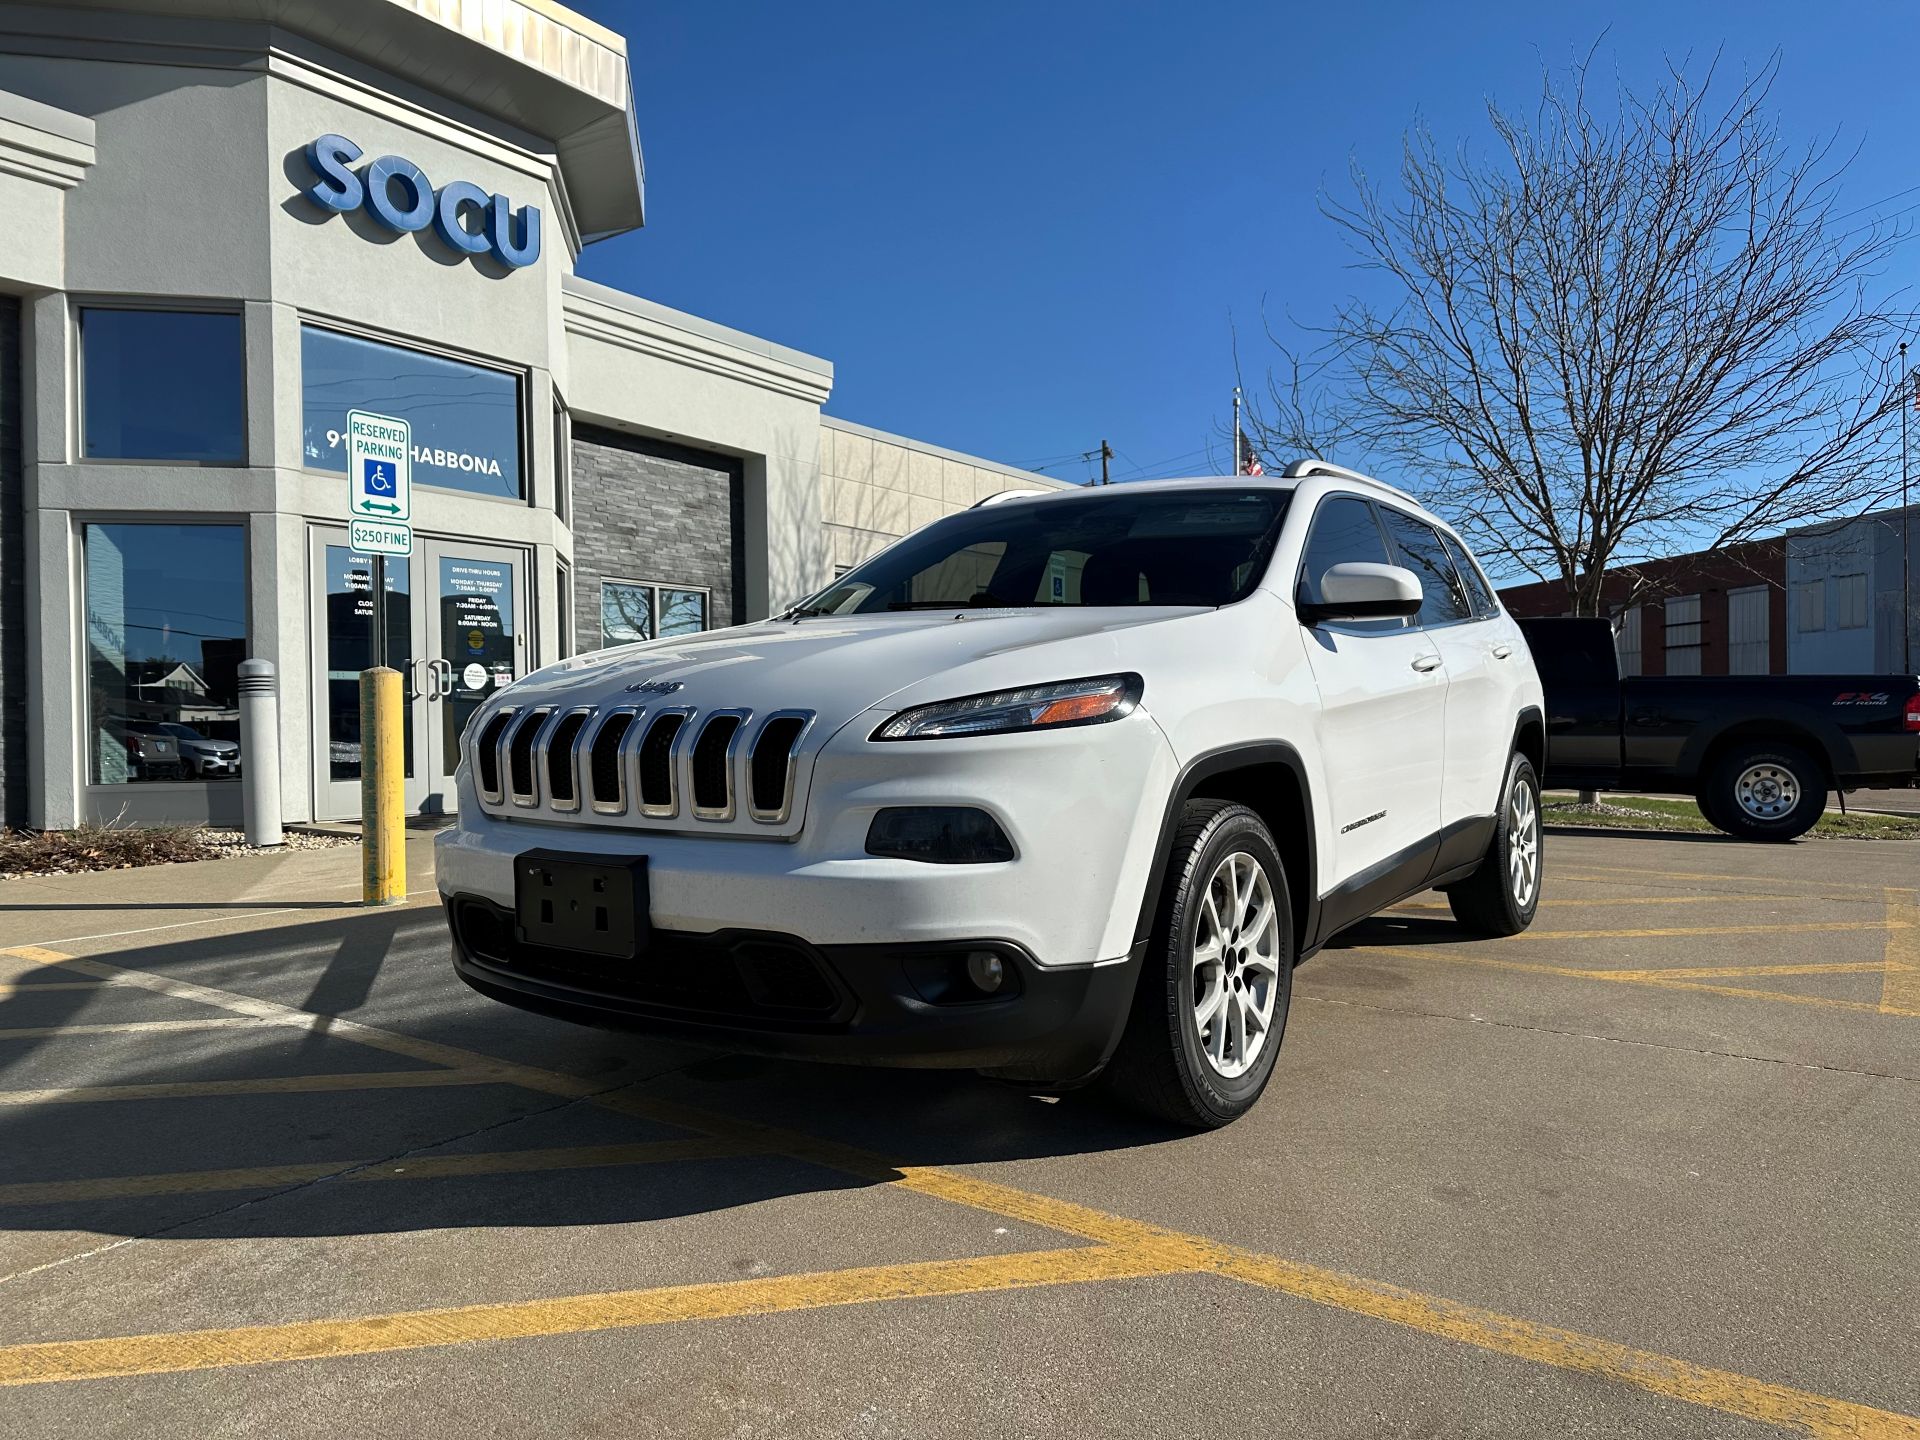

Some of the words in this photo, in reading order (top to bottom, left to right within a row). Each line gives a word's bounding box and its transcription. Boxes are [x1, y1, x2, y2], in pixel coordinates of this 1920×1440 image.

[306, 133, 541, 268] SOCU
[353, 421, 405, 443] RESERVED
[326, 429, 348, 451] 91
[410, 445, 502, 476] HABBONA
[356, 440, 402, 460] PARKING
[354, 527, 383, 544] $250
[384, 532, 408, 546] FINE
[348, 556, 367, 564] LOBBY
[343, 573, 370, 581] MONDAY
[476, 580, 502, 588] THURSDAY
[354, 608, 374, 616] SATUR
[624, 678, 684, 696] Jeep
[1834, 692, 1890, 701] FX4
